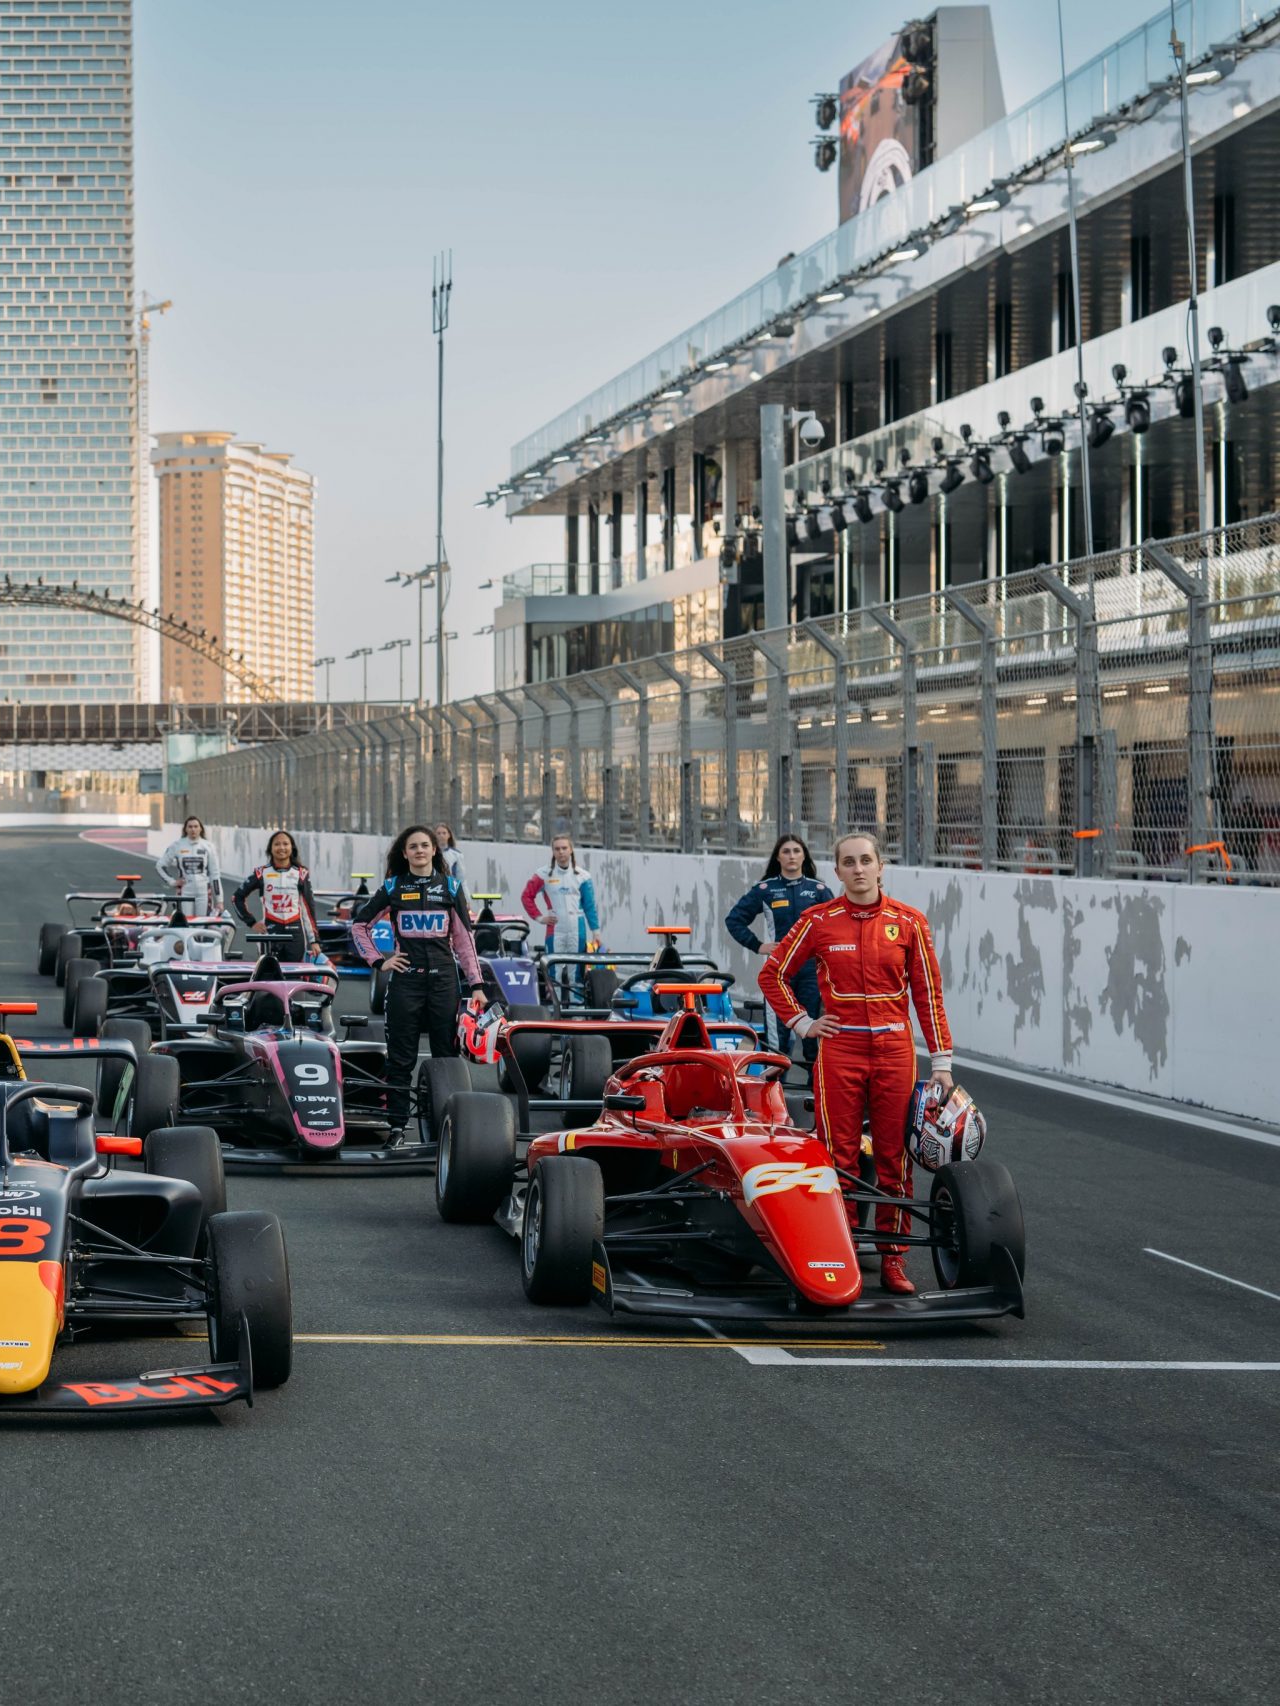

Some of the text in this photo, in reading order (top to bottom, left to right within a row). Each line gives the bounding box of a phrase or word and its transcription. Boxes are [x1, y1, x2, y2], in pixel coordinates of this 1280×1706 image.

[401, 914, 445, 931] BWT
[371, 928, 391, 940] 22
[504, 971, 531, 985] 17
[11, 1038, 100, 1050] Bull
[293, 1063, 330, 1086] 9
[307, 1095, 337, 1103] BWT
[741, 1161, 842, 1209] 64
[62, 1375, 241, 1406] Bull
